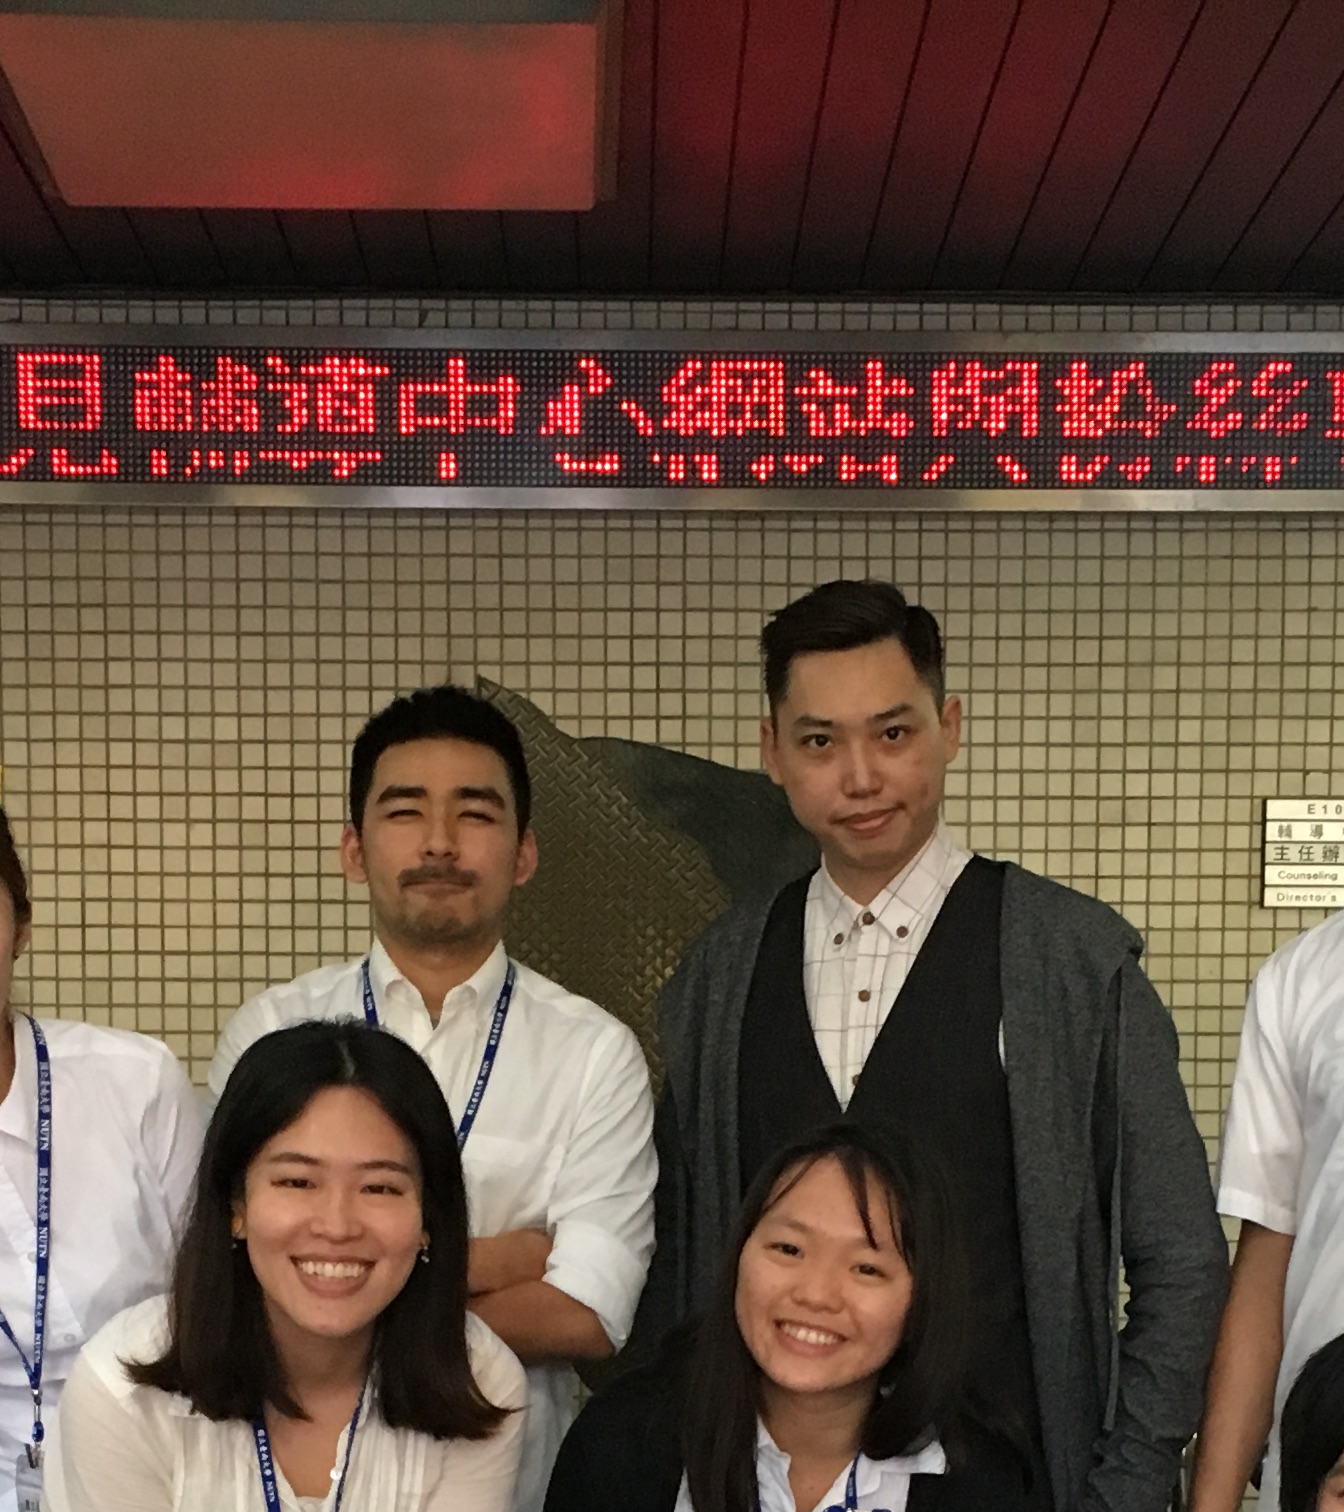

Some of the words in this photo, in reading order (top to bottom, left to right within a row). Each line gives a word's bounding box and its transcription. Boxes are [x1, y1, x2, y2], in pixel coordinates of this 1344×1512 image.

[1277, 870, 1338, 882] Counseling
[1276, 892, 1337, 903] Director's
[40, 1118, 51, 1151] NUTN
[38, 1226, 49, 1259] NUTN
